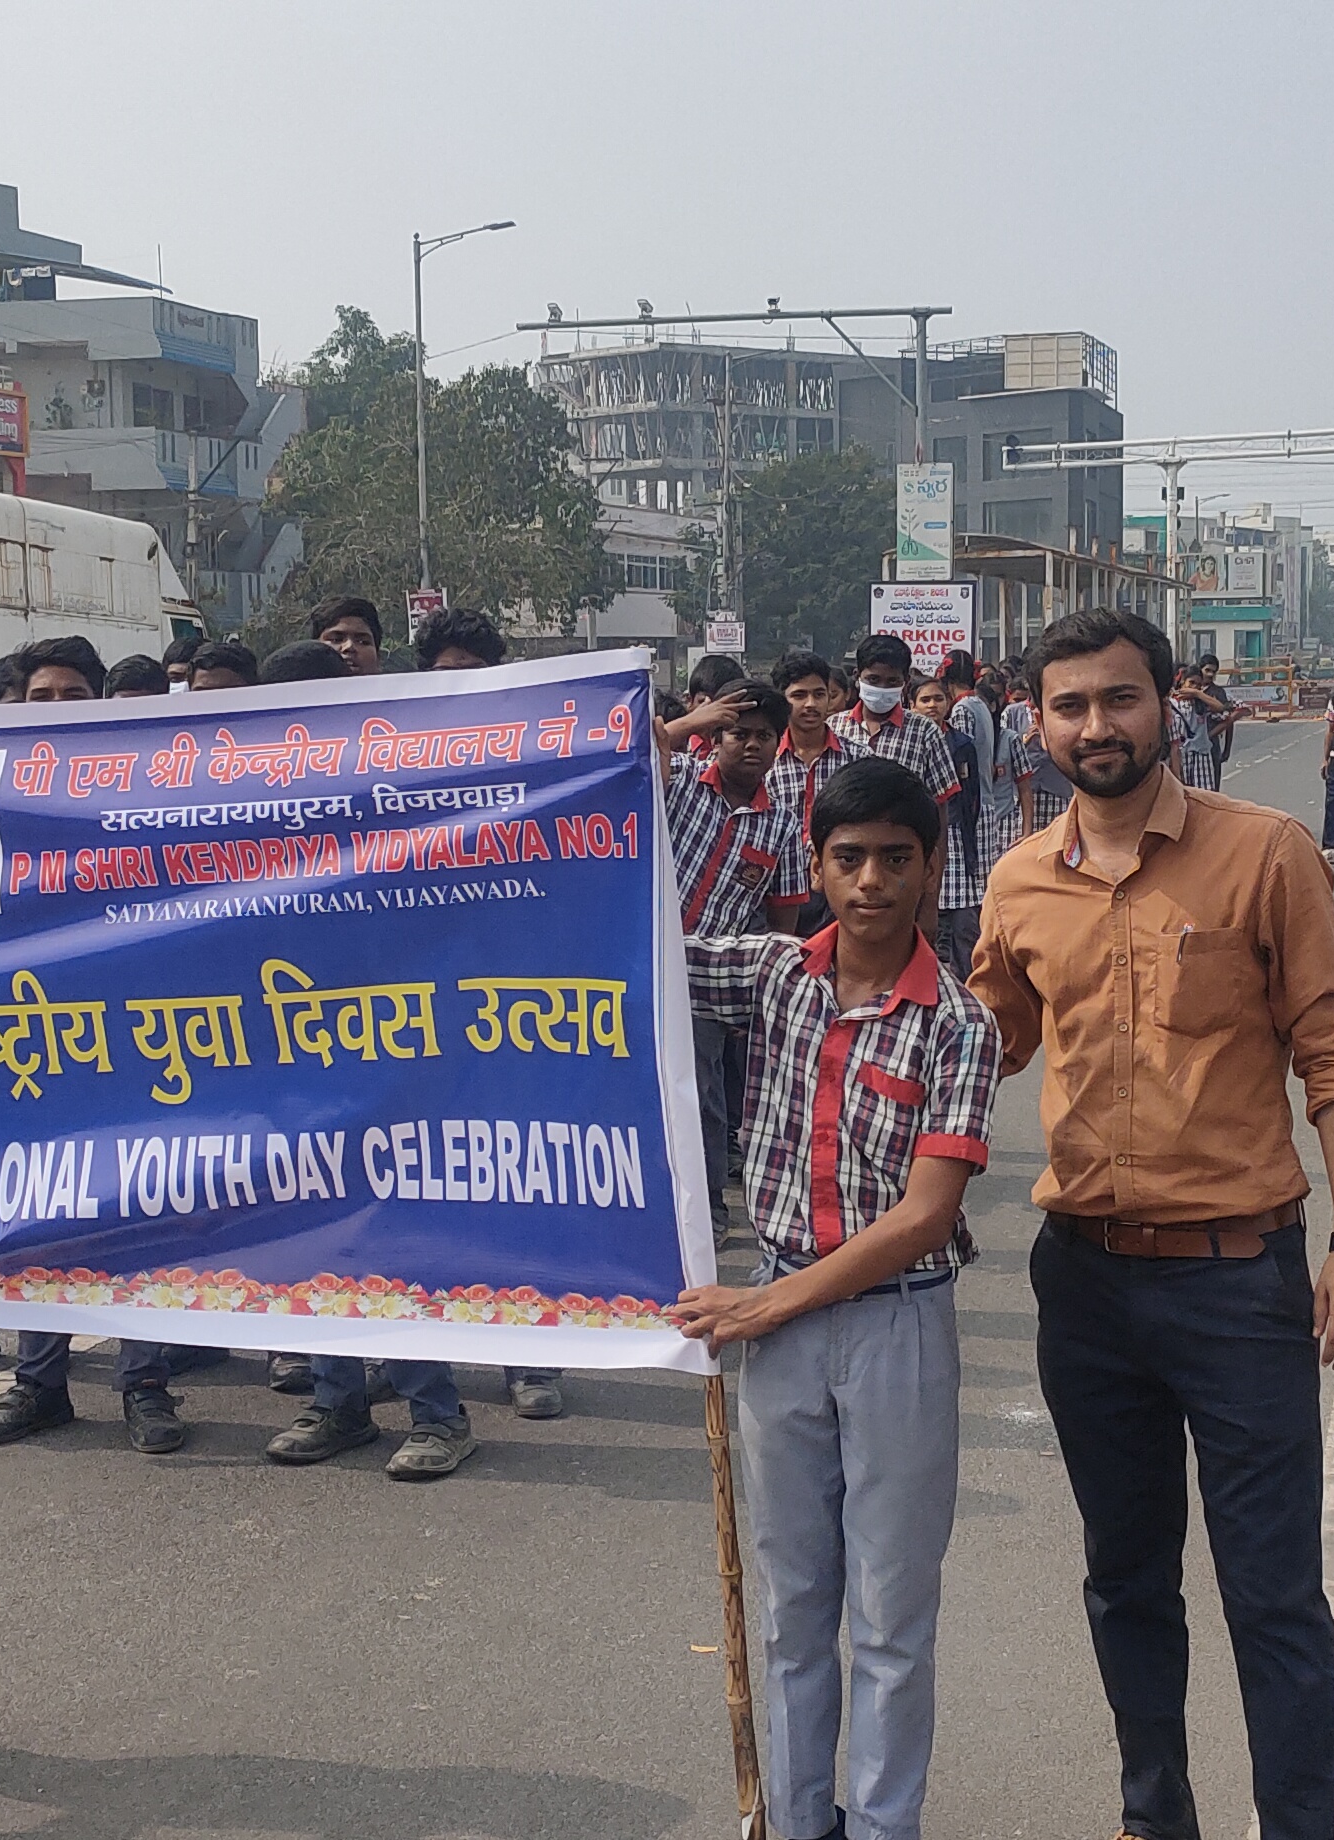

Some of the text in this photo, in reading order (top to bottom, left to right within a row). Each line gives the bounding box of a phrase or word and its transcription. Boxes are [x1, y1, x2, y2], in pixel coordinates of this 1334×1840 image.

[13, 741, 59, 796] पी
[68, 753, 138, 798] एम
[146, 732, 200, 788] श्री
[209, 724, 348, 787] केन्द्रीय
[355, 718, 527, 774] विद्यालय
[538, 700, 578, 758] नं
[10, 812, 638, 895] P M SHRI KENDRIYA VIDYALAYA NO.1
[105, 878, 546, 925] SATYANARAYANPURAM, VIJAYAWADA.
[125, 995, 251, 1105] युवा
[260, 958, 443, 1068] दिवस
[458, 977, 630, 1058] उत्सव
[117, 1134, 258, 1218] YOUTH
[266, 1131, 347, 1202] DAY
[362, 1119, 645, 1209] CELEBRATION
